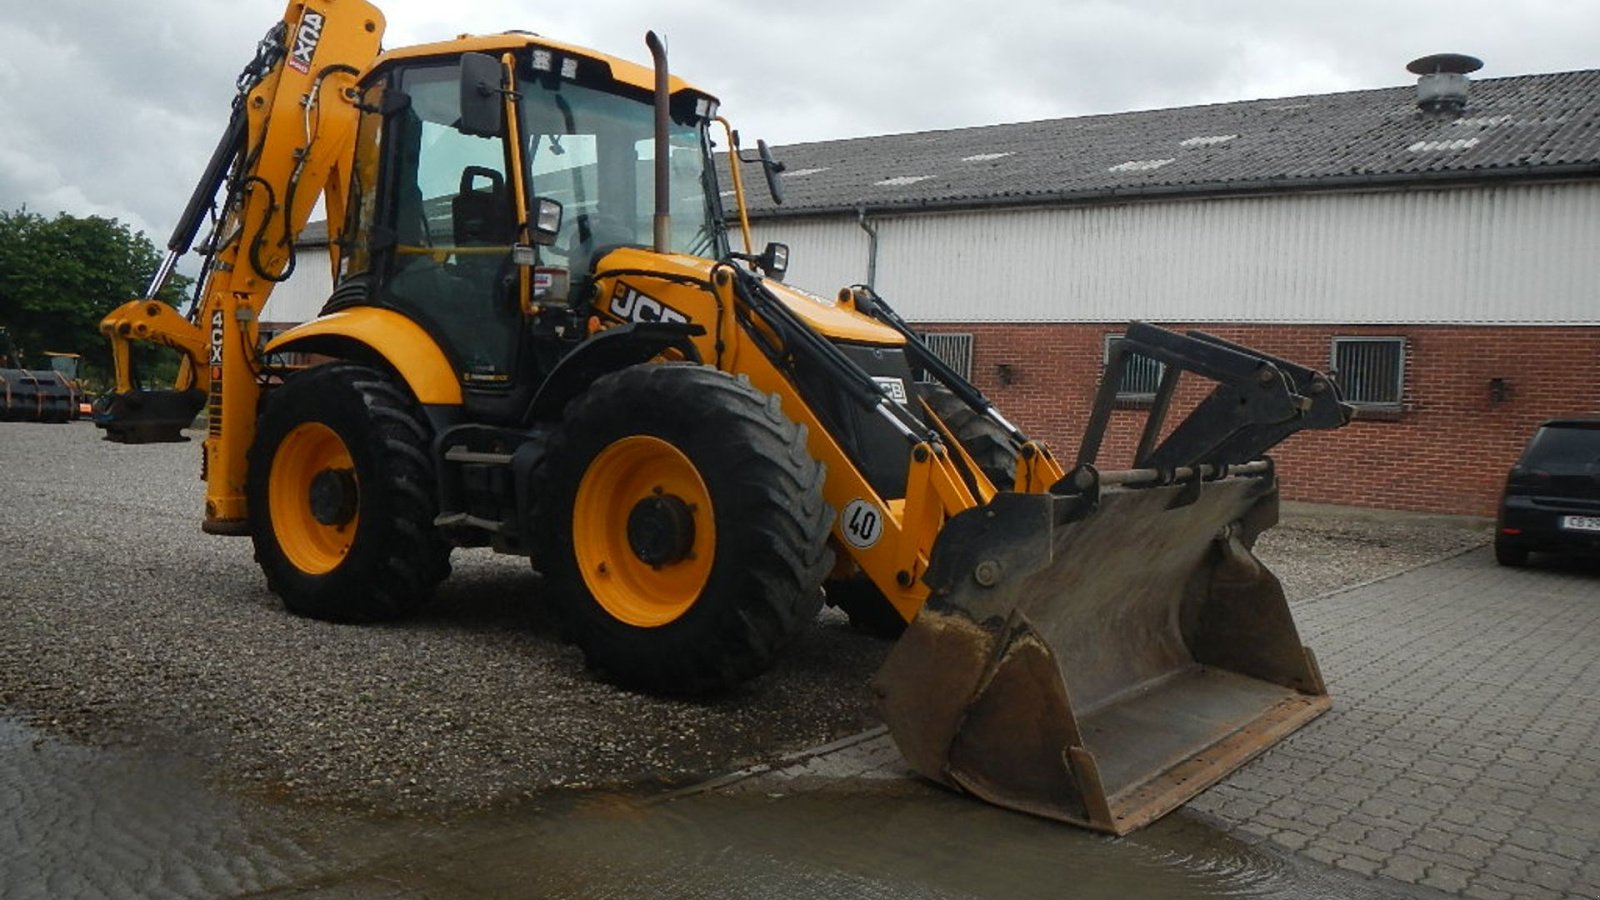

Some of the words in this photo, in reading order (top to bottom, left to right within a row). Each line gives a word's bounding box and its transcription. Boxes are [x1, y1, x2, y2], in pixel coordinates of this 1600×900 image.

[293, 13, 322, 62] 4CX
[211, 311, 223, 362] 4CX
[876, 382, 904, 398] CB
[849, 505, 876, 540] 40
